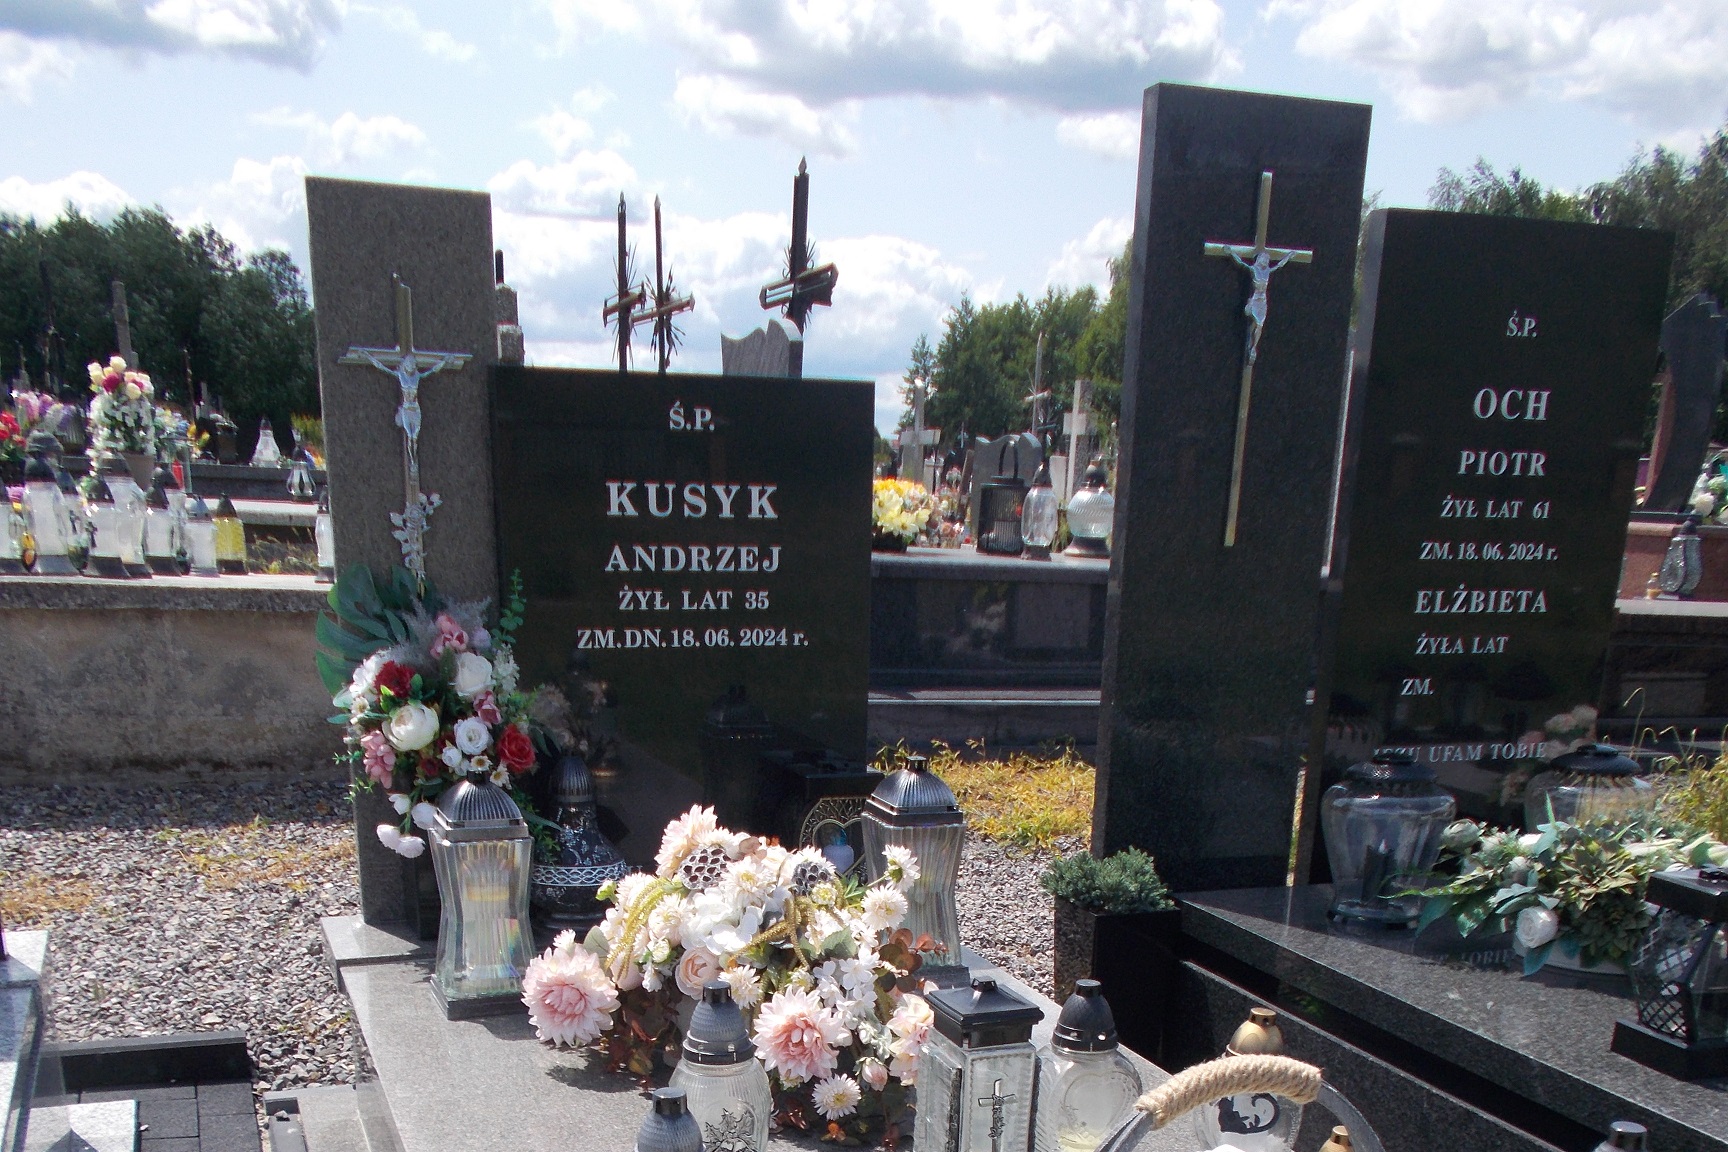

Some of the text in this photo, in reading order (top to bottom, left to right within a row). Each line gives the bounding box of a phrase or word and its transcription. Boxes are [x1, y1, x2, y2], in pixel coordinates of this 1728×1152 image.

[1506, 310, 1538, 338] Ś.P.
[669, 400, 716, 431] Ś.P.
[1473, 388, 1551, 421] OCH
[1457, 450, 1546, 476] PIOTR
[605, 482, 779, 519] KUSYK
[1440, 494, 1550, 519] ŻYŁ LAT 61
[604, 544, 782, 572] ANDRZEJ
[1418, 541, 1453, 561] ZM.
[618, 584, 771, 612] ŻYŁ LAT 35
[1414, 583, 1548, 614] ELŻBIETA
[1415, 632, 1510, 655] ŻYŁA LAT
[1400, 678, 1434, 696] ZM.
[1428, 744, 1483, 763] UFAM
[1490, 742, 1548, 761] TOBIE
